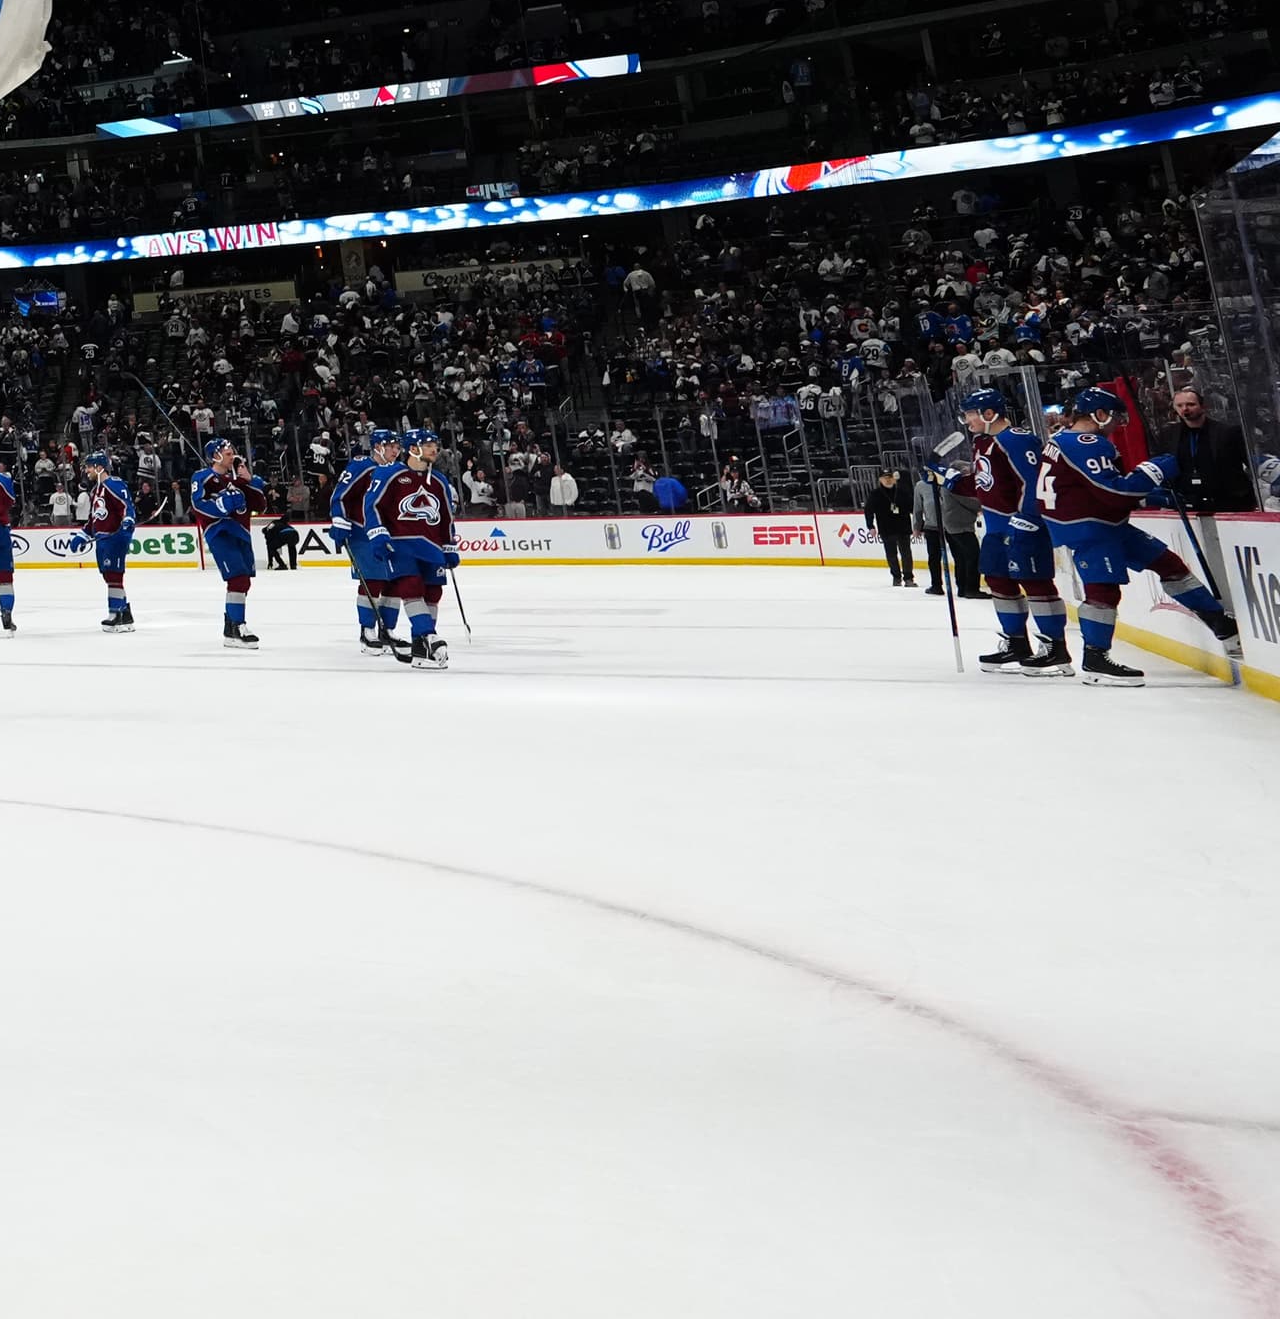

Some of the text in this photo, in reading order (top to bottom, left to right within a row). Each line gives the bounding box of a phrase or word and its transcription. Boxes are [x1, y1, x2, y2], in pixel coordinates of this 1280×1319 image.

[1069, 208, 1083, 220] 29
[148, 222, 277, 258] AVS WIN
[865, 347, 879, 360] 29
[1025, 450, 1038, 465] 8
[1086, 454, 1115, 474] 94
[641, 520, 692, 554] Ball
[753, 526, 815, 546] ESPN
[503, 538, 552, 552] LIGHT
